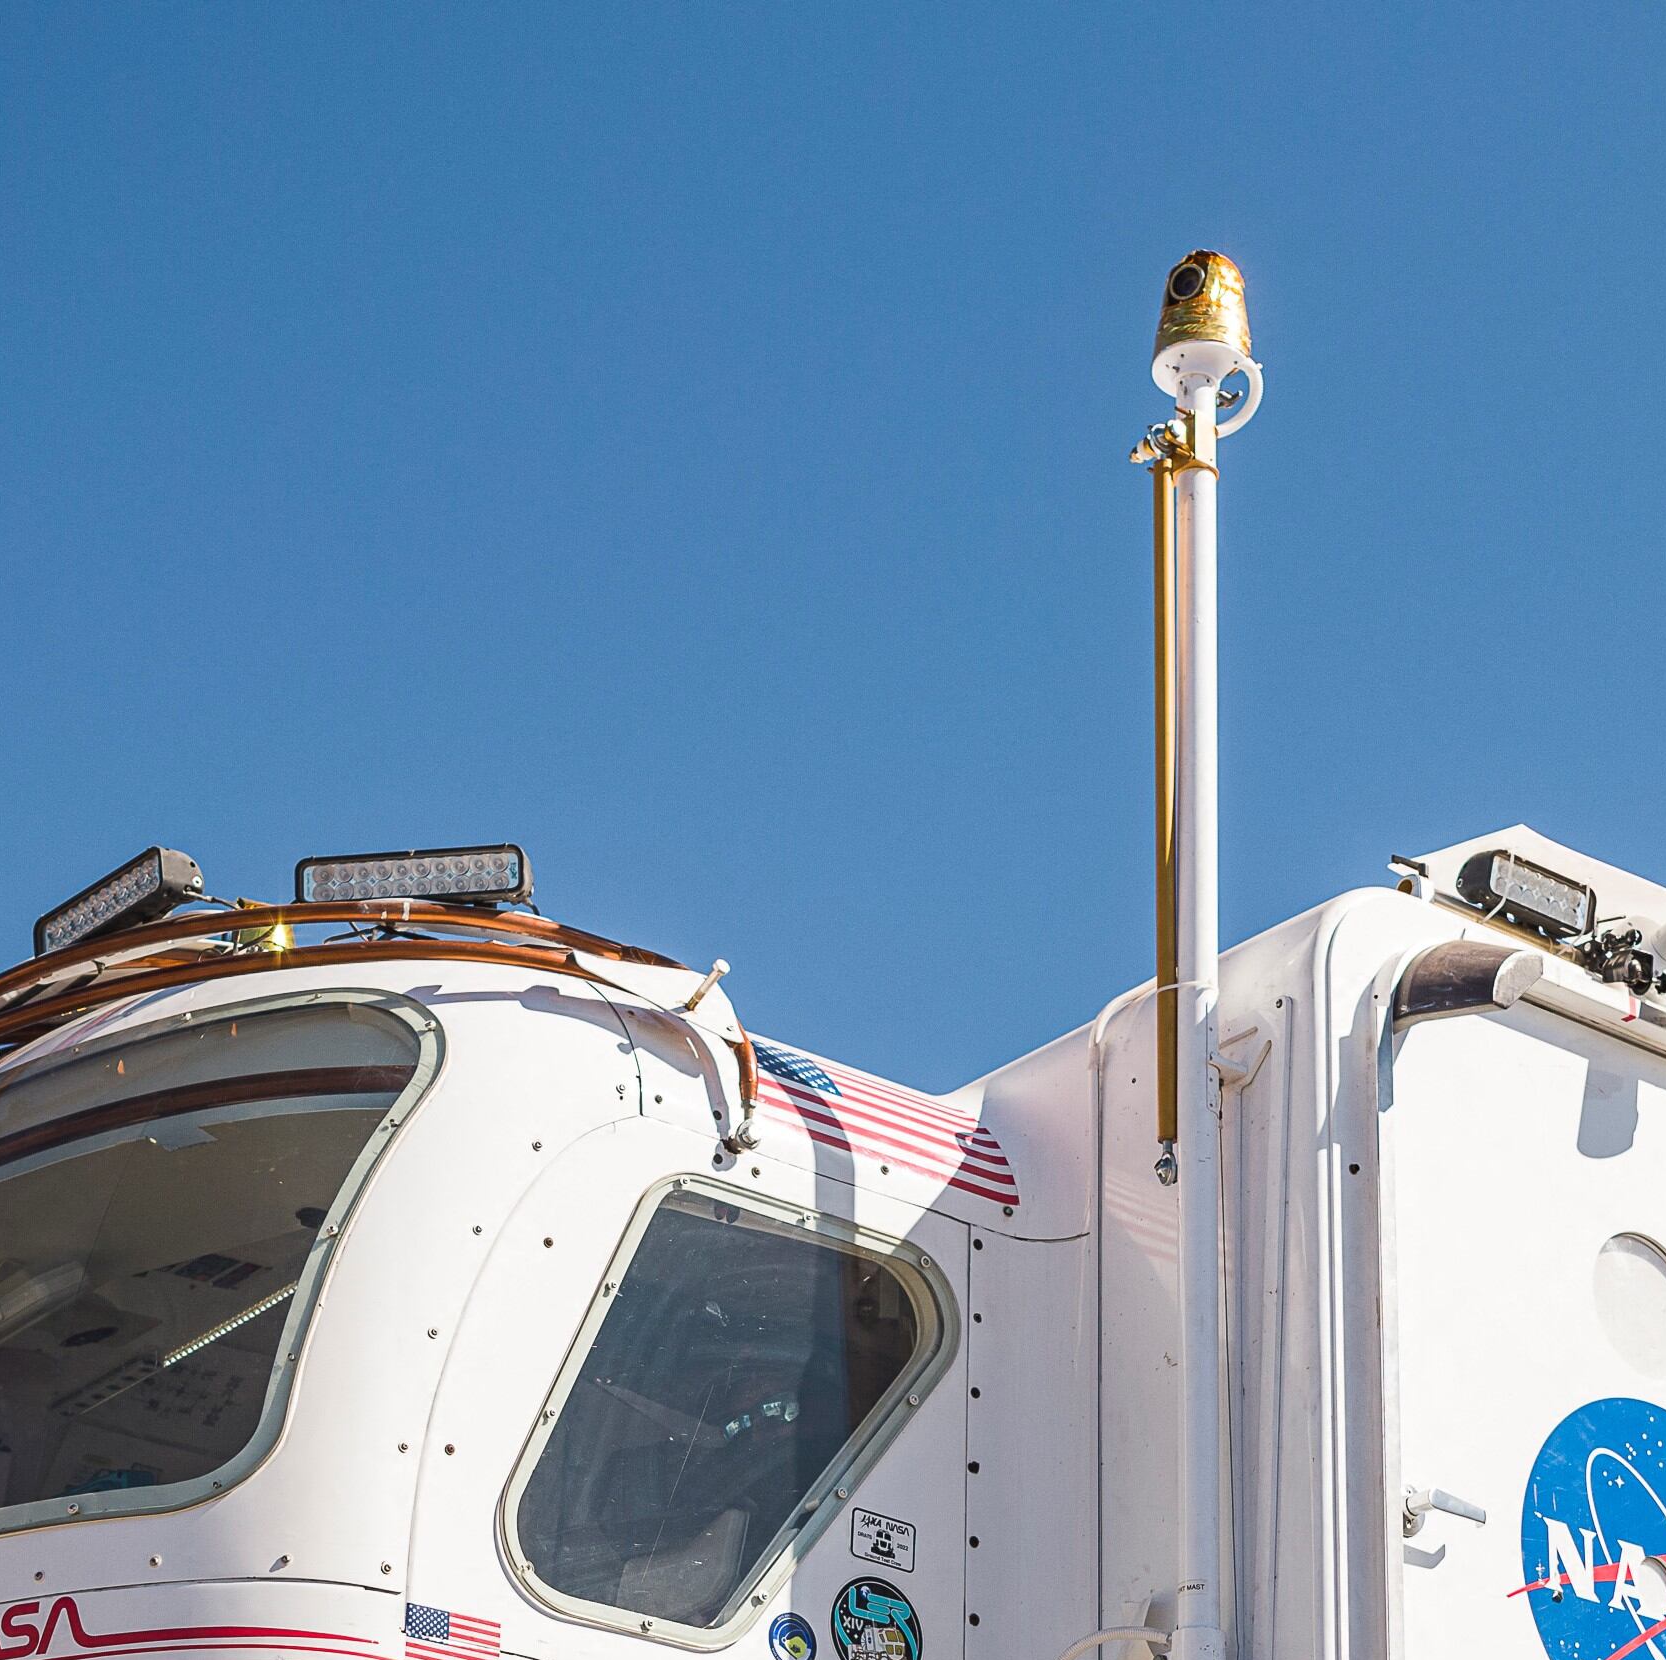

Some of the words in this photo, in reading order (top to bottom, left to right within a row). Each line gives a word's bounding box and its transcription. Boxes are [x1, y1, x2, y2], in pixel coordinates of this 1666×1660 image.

[860, 1514, 882, 1529] JAXA
[885, 1521, 910, 1537] NASA
[896, 1542, 909, 1552] 2022
[1186, 1583, 1205, 1591] MAST
[843, 1615, 864, 1631] XIV
